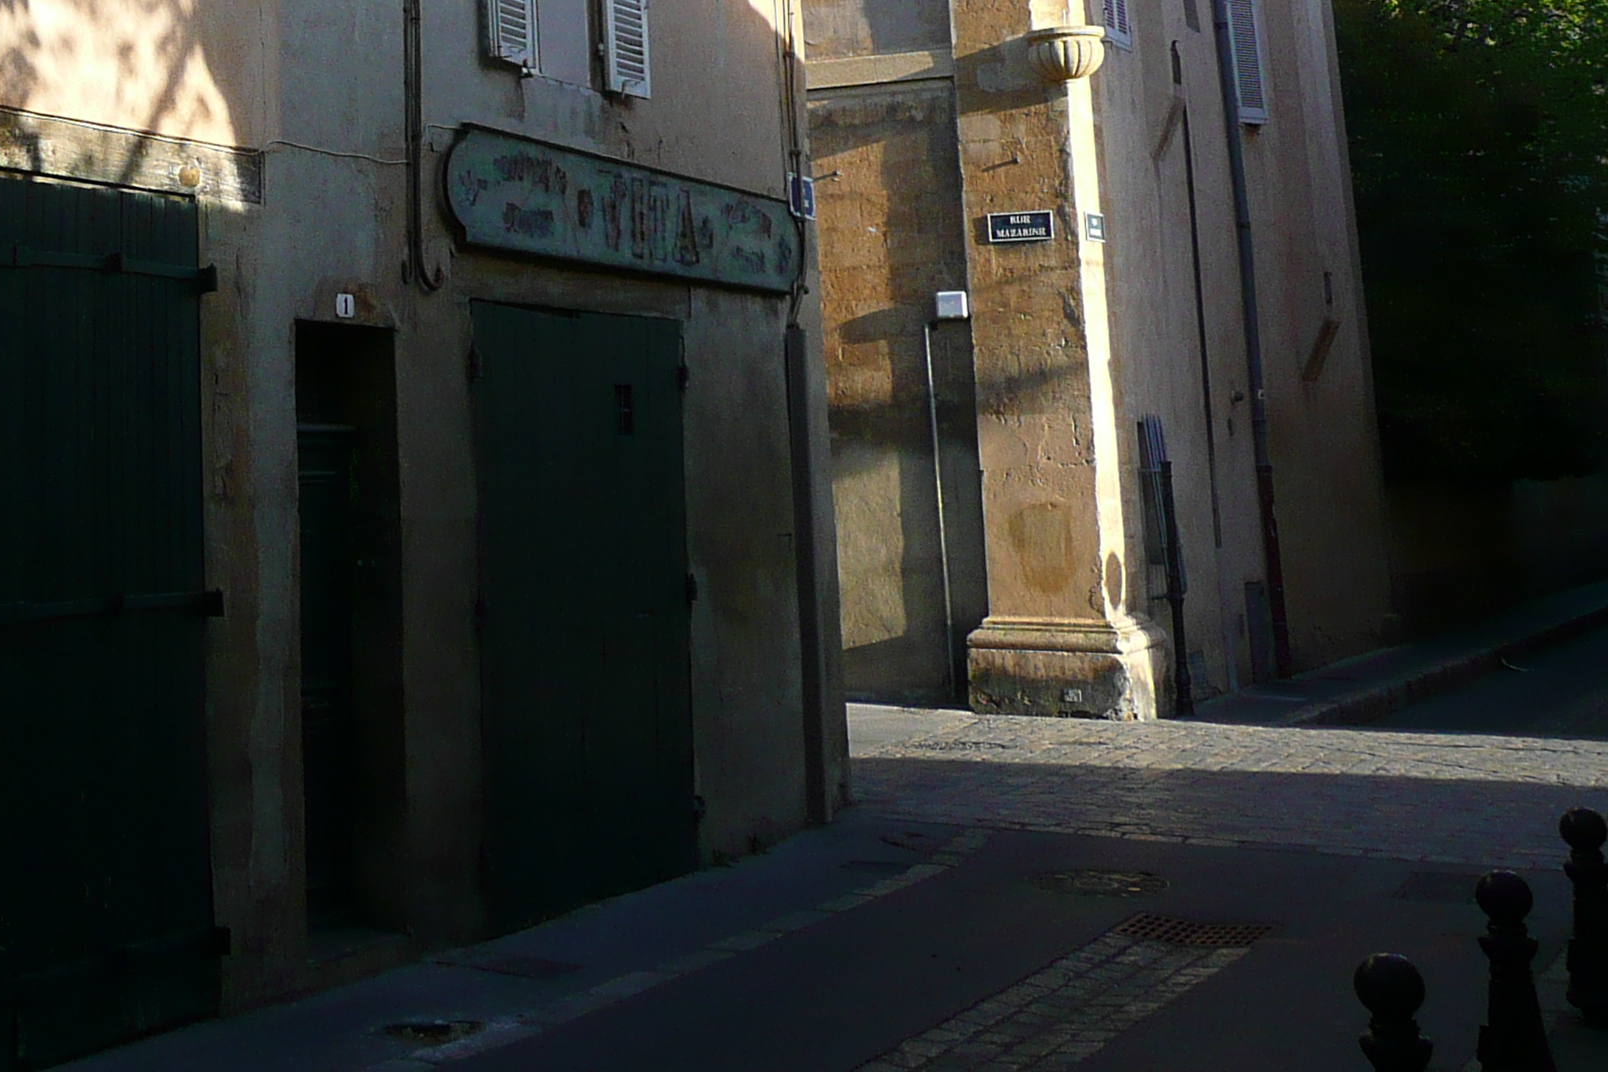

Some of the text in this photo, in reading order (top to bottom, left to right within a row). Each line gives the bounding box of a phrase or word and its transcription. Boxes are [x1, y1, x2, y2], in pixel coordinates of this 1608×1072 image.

[1009, 215, 1031, 225] RUE
[996, 227, 1046, 237] MAZARINE
[343, 296, 350, 315] 1
